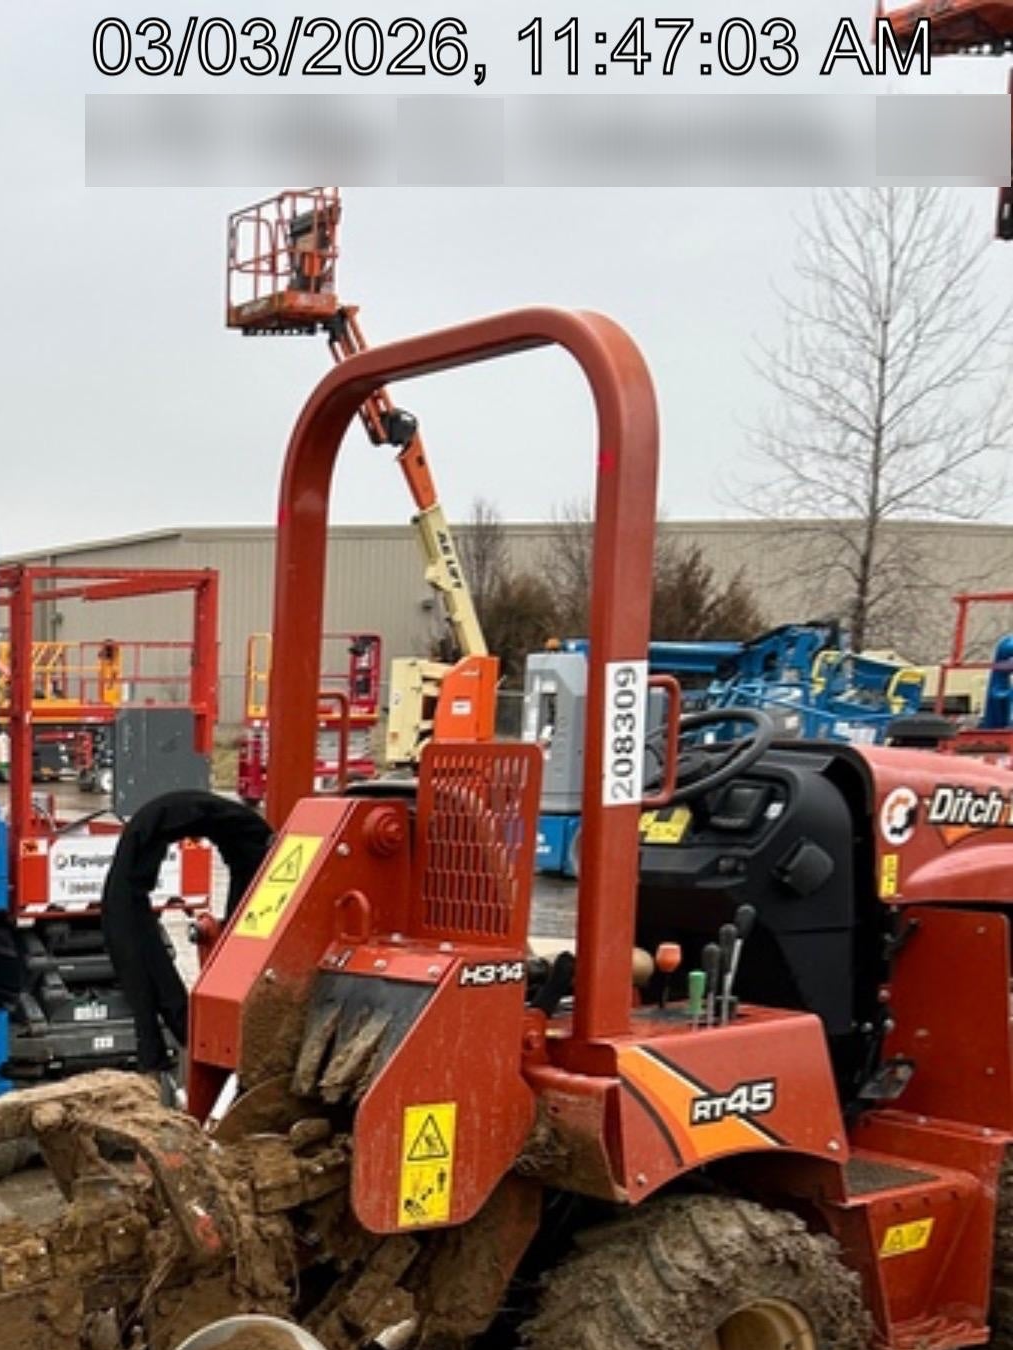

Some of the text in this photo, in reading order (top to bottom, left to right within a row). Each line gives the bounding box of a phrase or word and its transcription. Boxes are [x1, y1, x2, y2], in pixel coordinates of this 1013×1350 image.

[611, 666, 637, 799] 208309
[928, 785, 1004, 826] Ditch
[459, 961, 525, 986] H314
[691, 1081, 776, 1123] RT45
